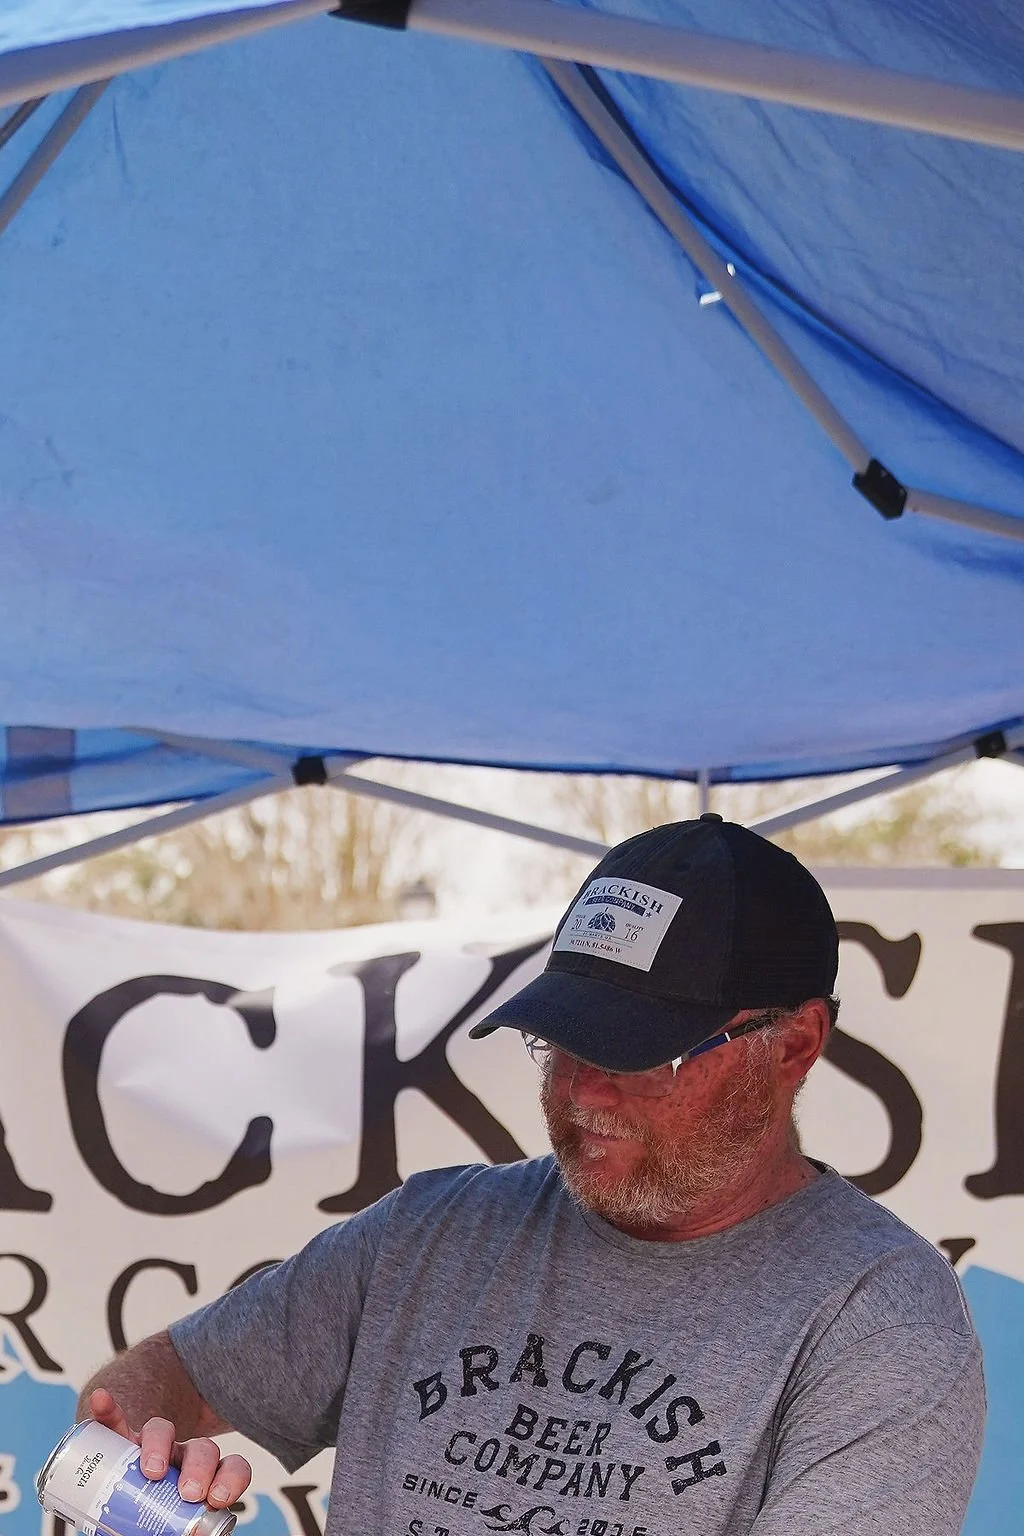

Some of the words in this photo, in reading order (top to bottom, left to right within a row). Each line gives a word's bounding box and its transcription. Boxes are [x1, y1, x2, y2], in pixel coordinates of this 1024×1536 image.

[625, 928, 638, 942] 16
[413, 1334, 727, 1495] BRACKISH
[505, 1404, 611, 1457] BEER
[403, 1473, 479, 1509] SINCE
[443, 1431, 645, 1501] COMPANY
